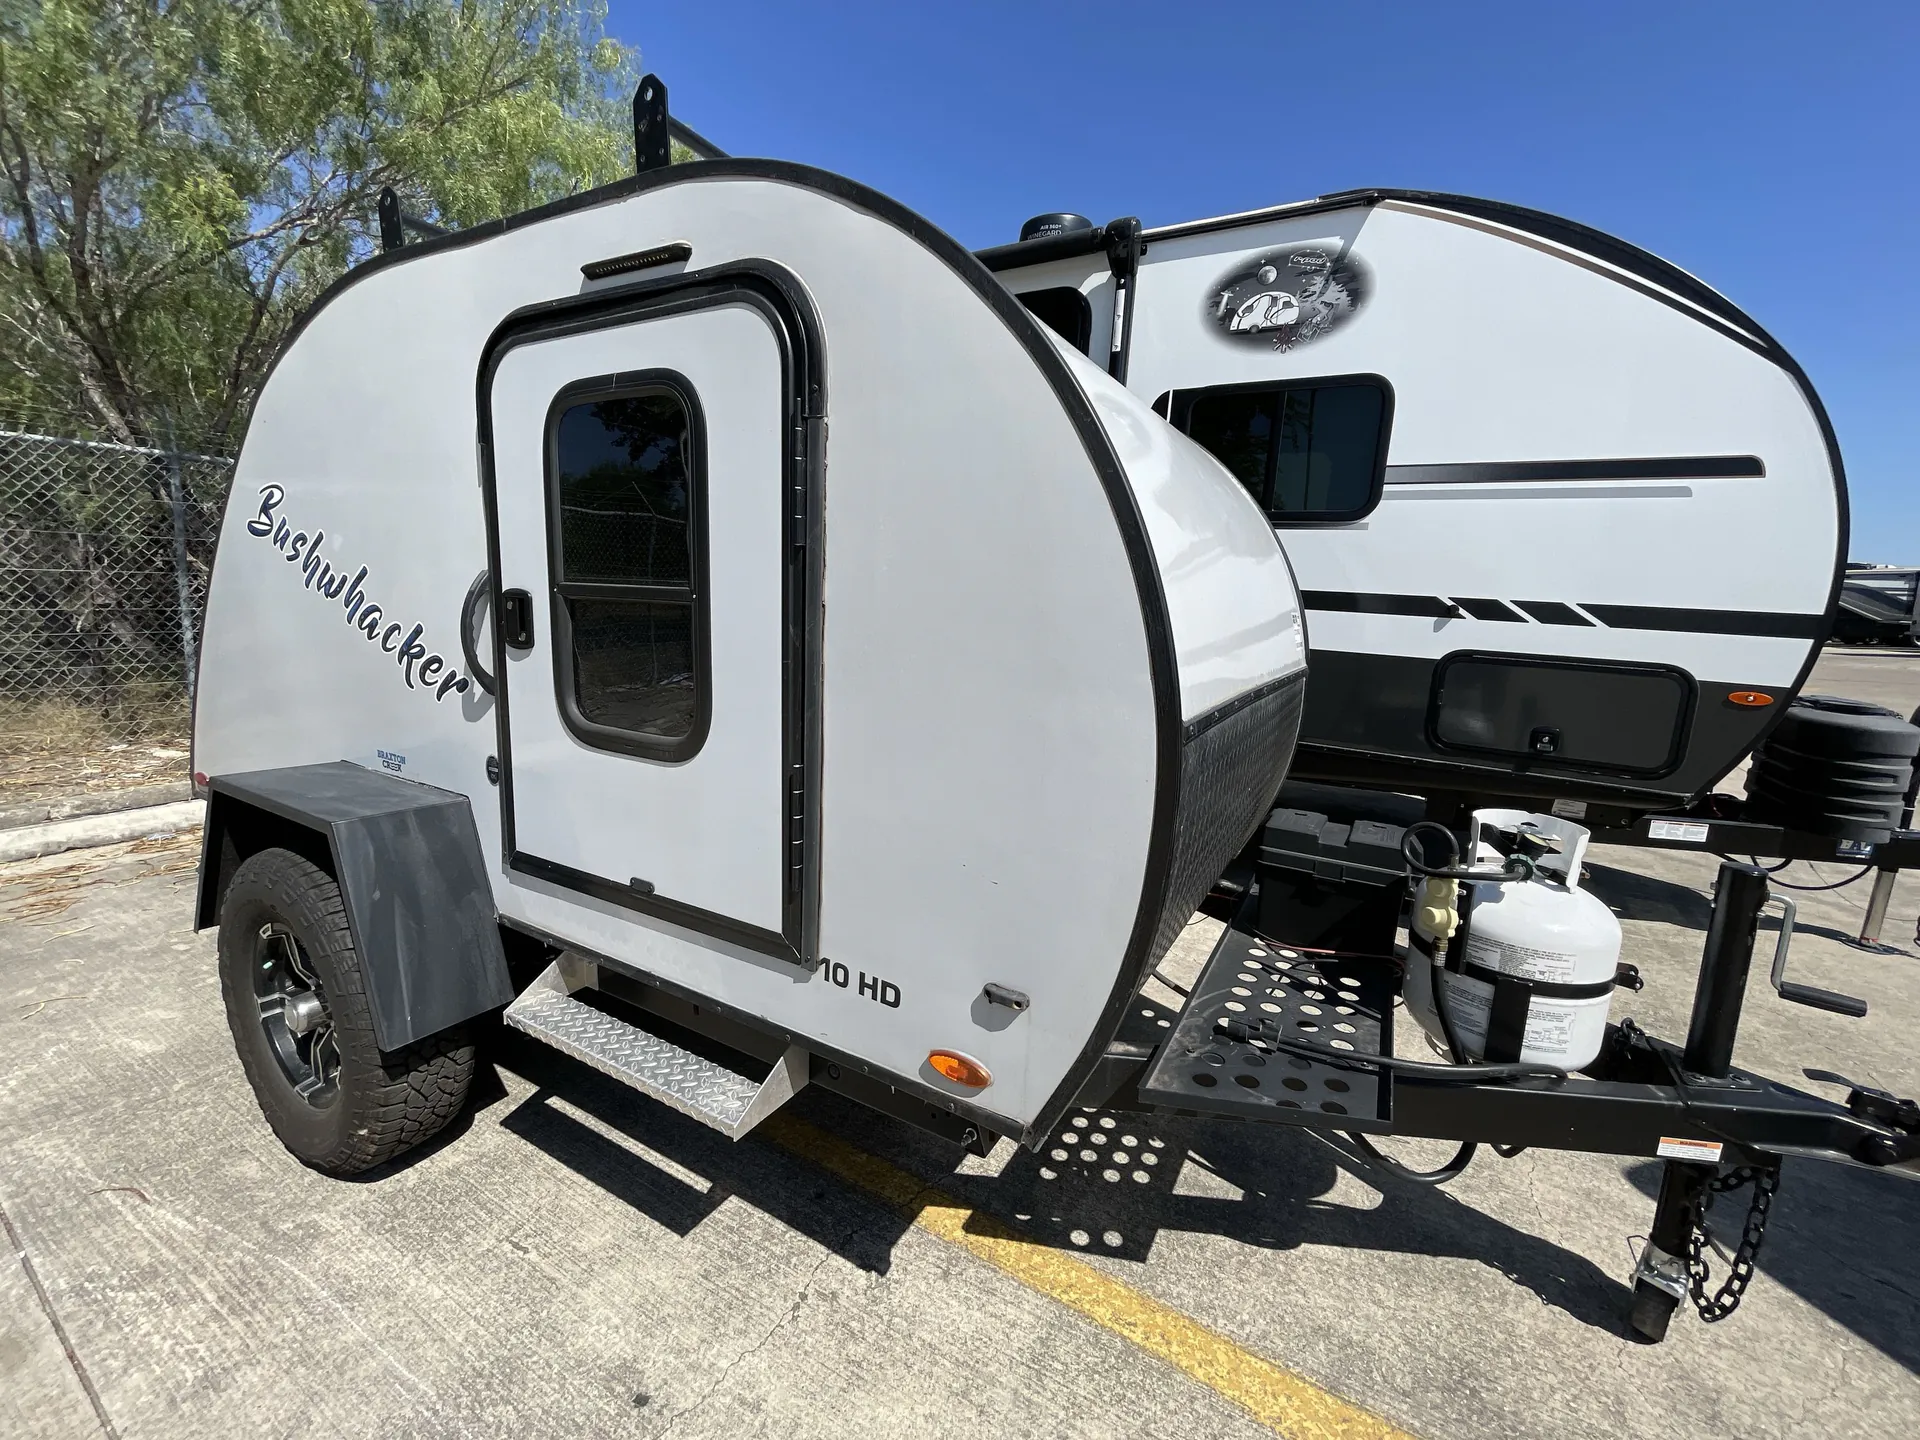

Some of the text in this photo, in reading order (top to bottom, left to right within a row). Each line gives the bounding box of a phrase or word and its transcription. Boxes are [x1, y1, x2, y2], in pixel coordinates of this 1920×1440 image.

[1027, 229, 1062, 240] WINEGARD
[246, 483, 470, 702] Bushwhacker
[377, 749, 406, 764] BRAXTON
[382, 760, 402, 773] CREEK
[818, 957, 901, 1009] 10 HD
